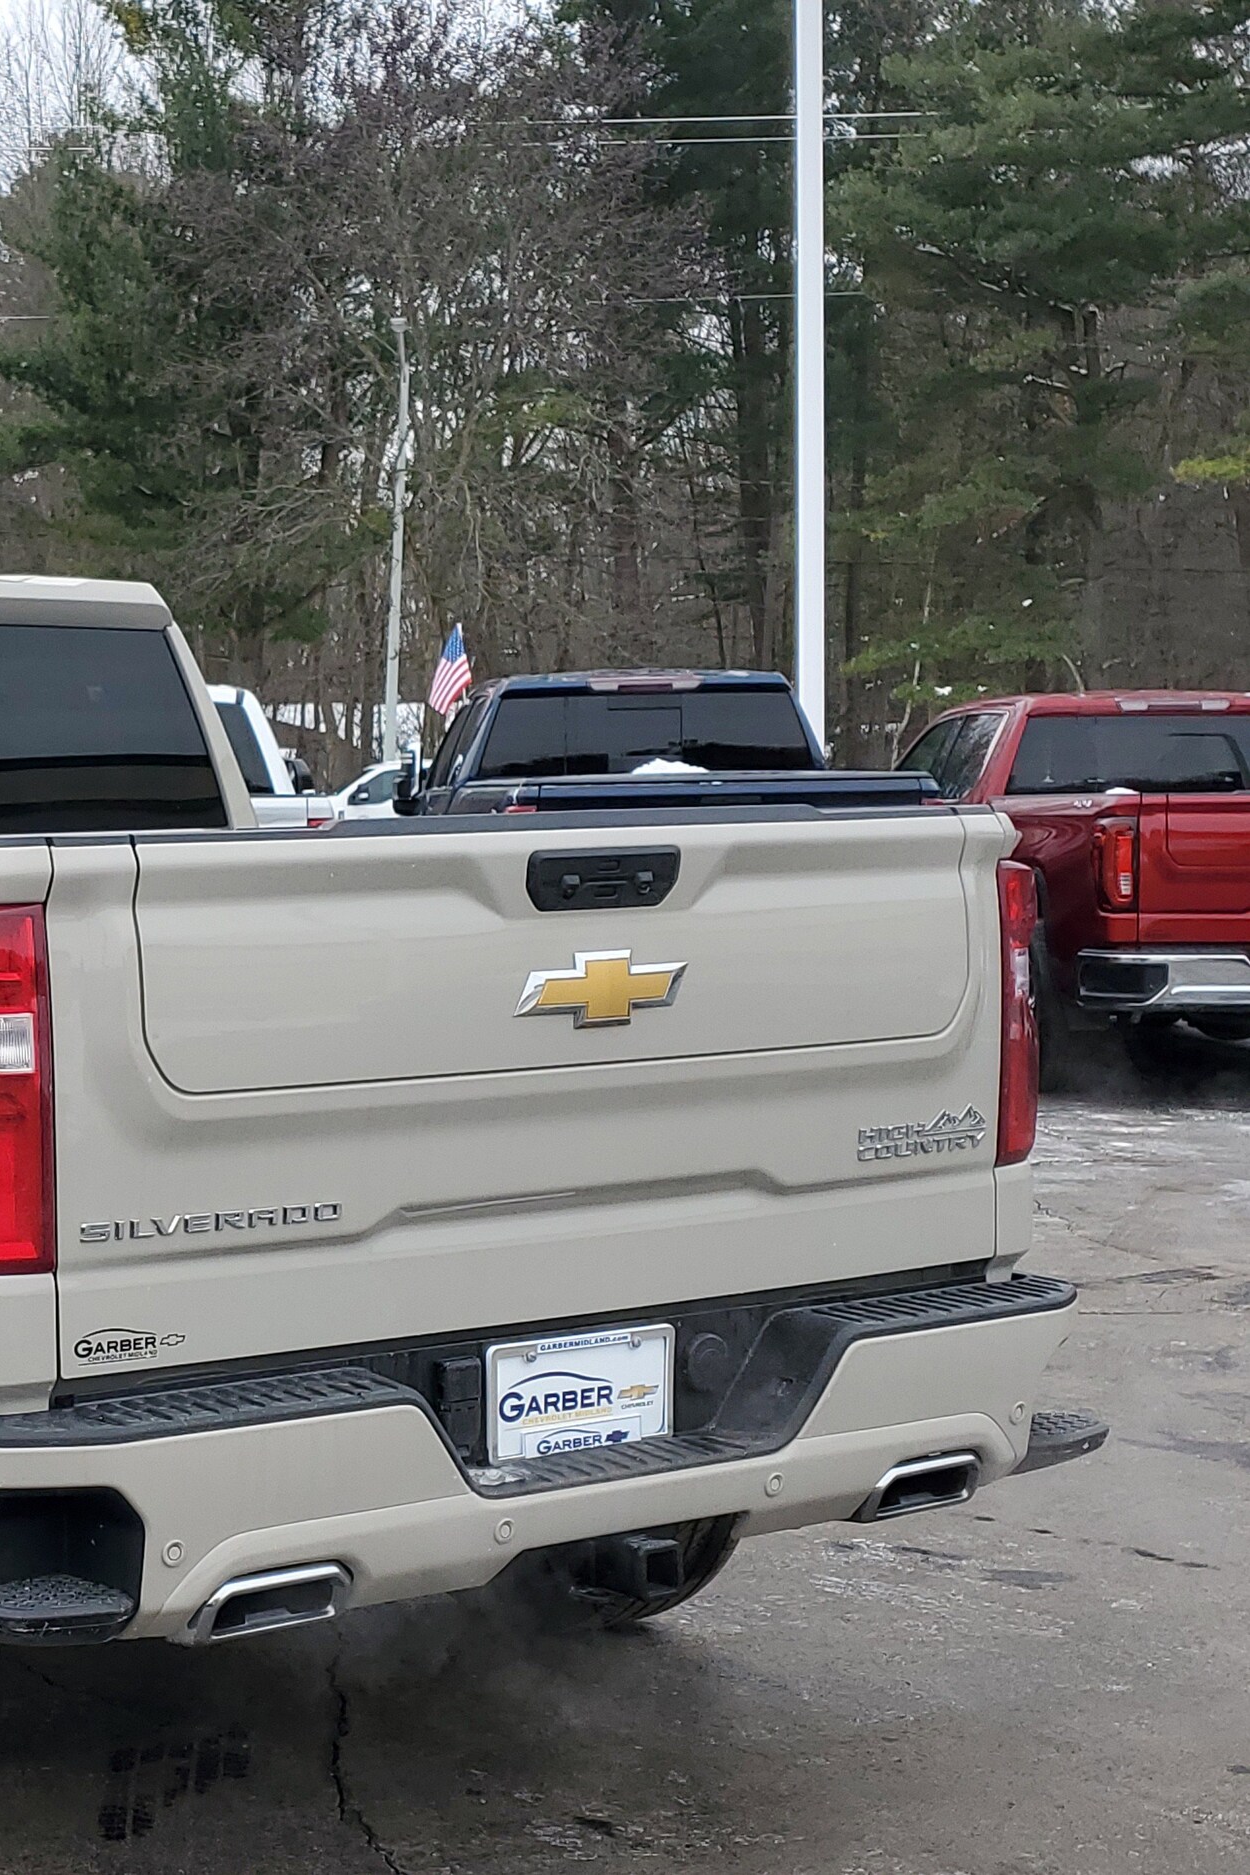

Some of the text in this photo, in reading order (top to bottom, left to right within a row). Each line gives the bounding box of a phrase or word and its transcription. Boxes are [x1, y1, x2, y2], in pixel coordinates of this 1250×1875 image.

[858, 1122, 926, 1145] HIGH
[857, 1132, 986, 1162] COUNTRY
[79, 1201, 342, 1243] SILVERADO
[74, 1336, 157, 1359] GARBER
[88, 1349, 158, 1363] CHEVROLET MIDLAND
[499, 1385, 614, 1423] GARBER
[621, 1400, 654, 1410] CHEVROLET
[522, 1406, 613, 1426] CHEVROLET MIDLAND
[537, 1434, 603, 1456] GARBER
